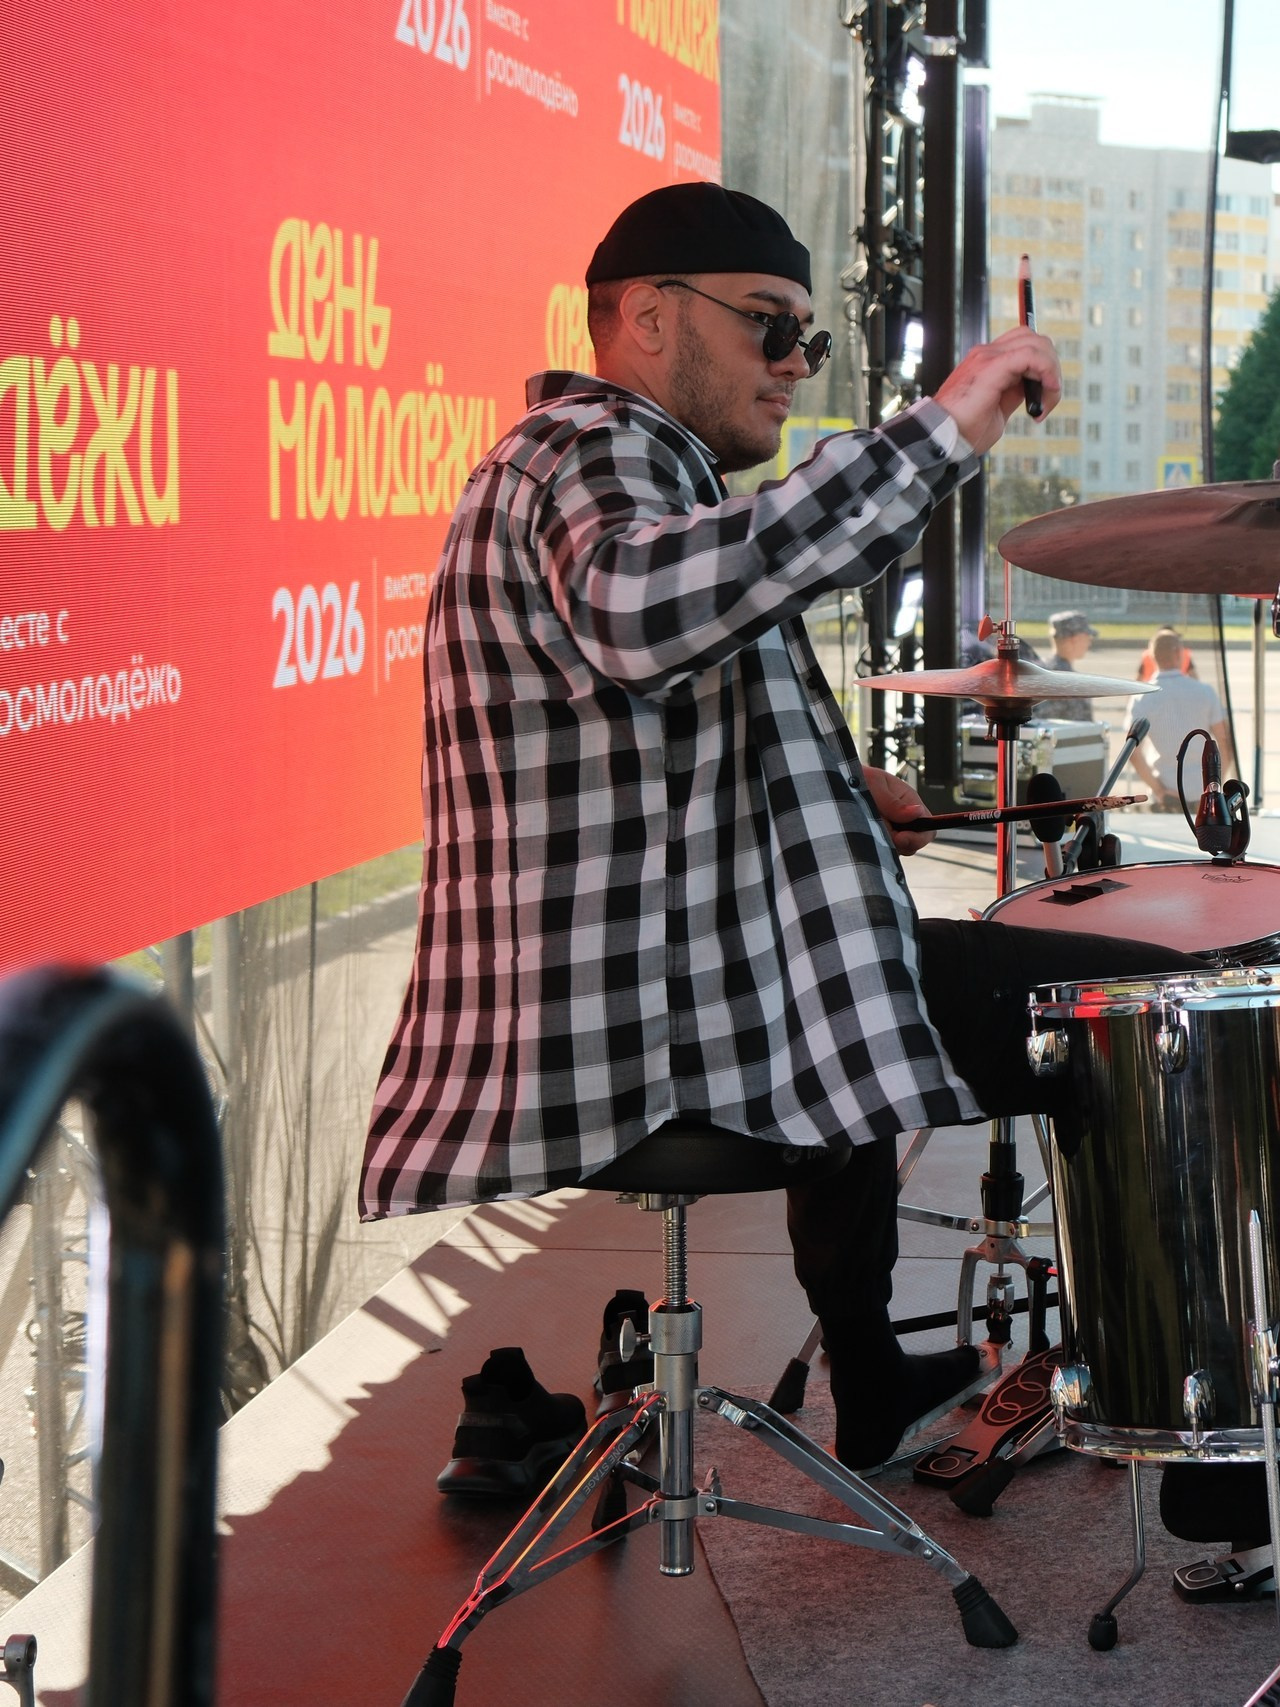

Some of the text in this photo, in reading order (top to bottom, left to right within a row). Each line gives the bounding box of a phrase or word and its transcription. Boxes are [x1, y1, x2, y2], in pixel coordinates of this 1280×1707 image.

[395, 0, 470, 71] 2026
[618, 72, 666, 162] 2026
[384, 572, 427, 601] вместе
[56, 608, 70, 644] с
[272, 581, 365, 690] 2026
[582, 1442, 626, 1496] ONE STAGE
